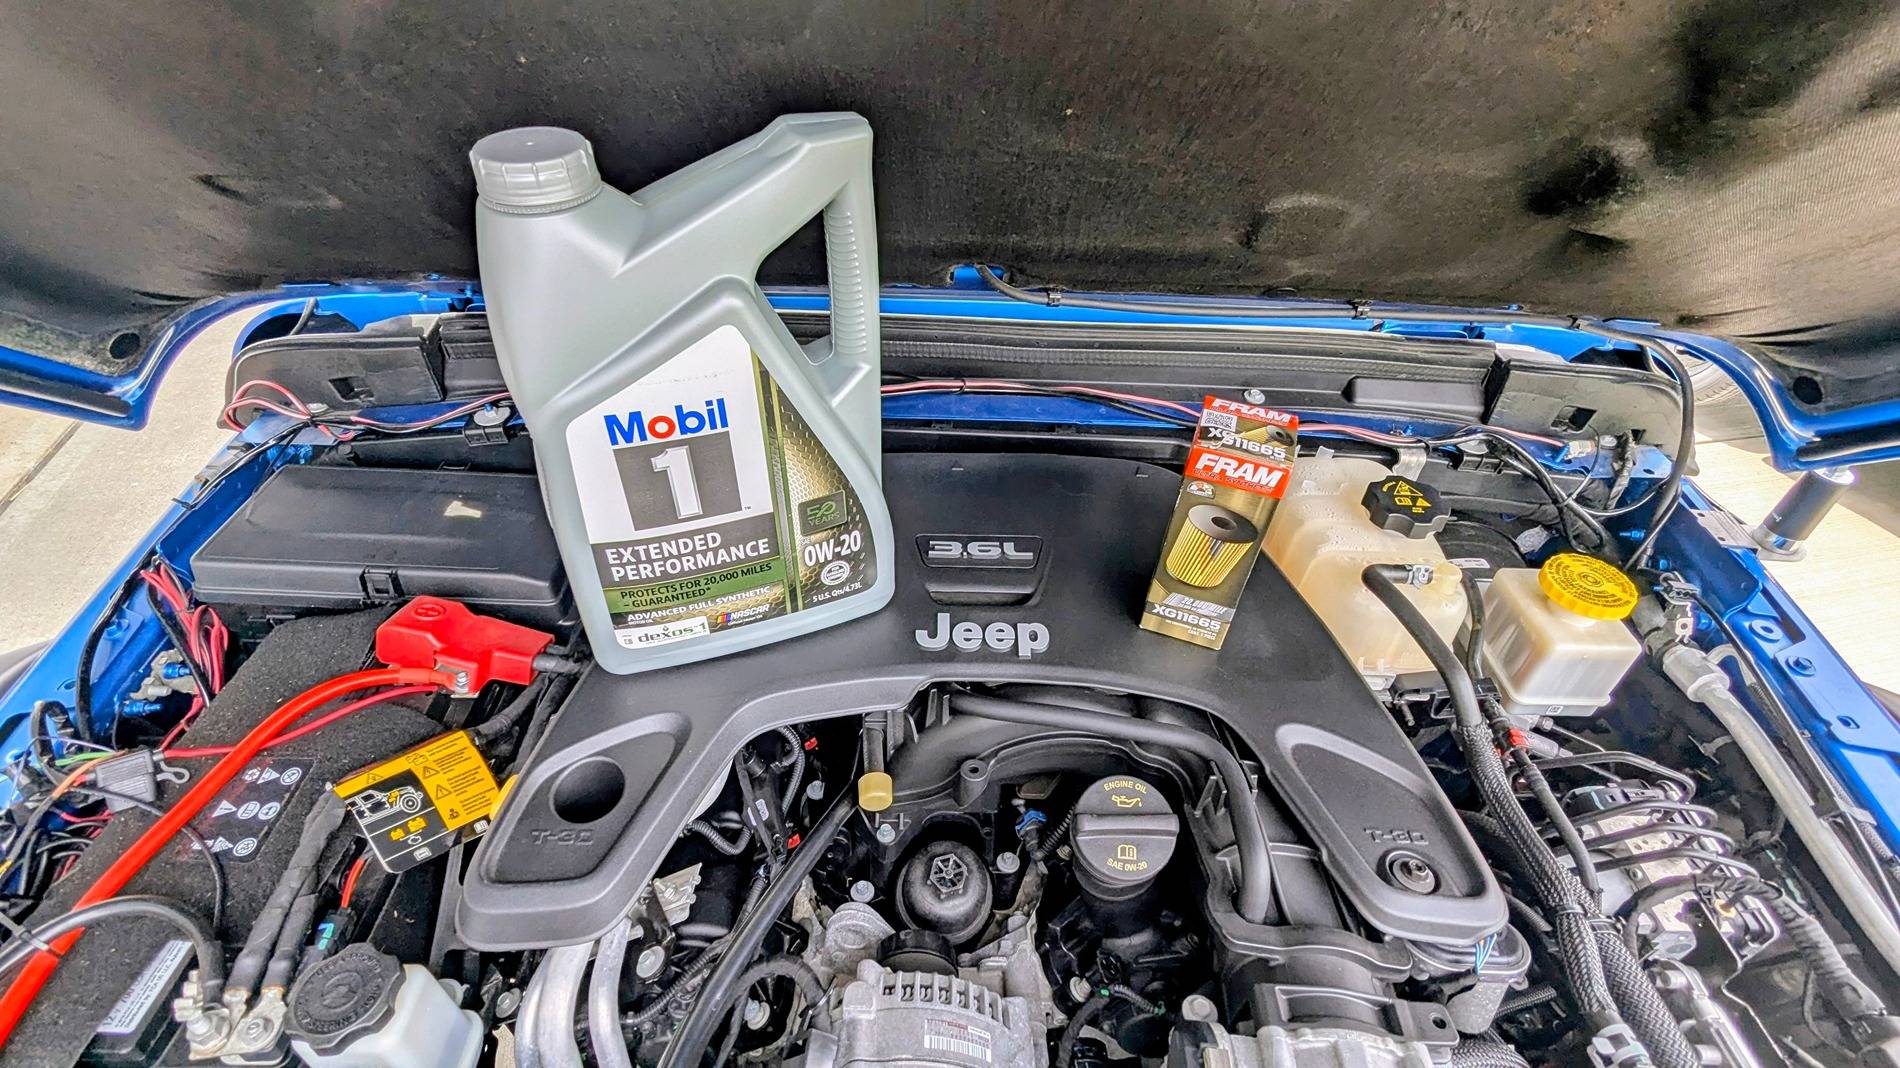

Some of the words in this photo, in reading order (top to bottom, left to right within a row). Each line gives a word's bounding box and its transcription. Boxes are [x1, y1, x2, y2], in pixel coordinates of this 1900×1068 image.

[603, 397, 729, 446] Mobil
[1211, 398, 1292, 424] FRAM
[650, 445, 704, 520] 1
[1194, 453, 1284, 488] FRAM
[808, 512, 840, 527] YEARS
[605, 532, 722, 565] EXTENDED
[610, 538, 770, 582] PERFORMANCE
[804, 530, 862, 567] 0W-20
[928, 541, 1034, 560] 3.6L
[620, 584, 678, 600] PROTECTS
[679, 579, 702, 590] FOR
[704, 572, 739, 587] 20,000
[741, 562, 773, 578] MILES
[627, 606, 687, 622] ADVANCED
[688, 601, 715, 612] FULL
[715, 585, 771, 605] SYNTHETIC
[730, 603, 770, 619] NASCAR
[1152, 603, 1222, 631] XG11665
[638, 627, 694, 643] dexos
[915, 612, 1050, 660] Jeep
[1103, 780, 1134, 792] ENGINE
[1134, 782, 1149, 795] OIL
[1106, 857, 1123, 870] SAE
[1124, 861, 1148, 872] 0W-20
